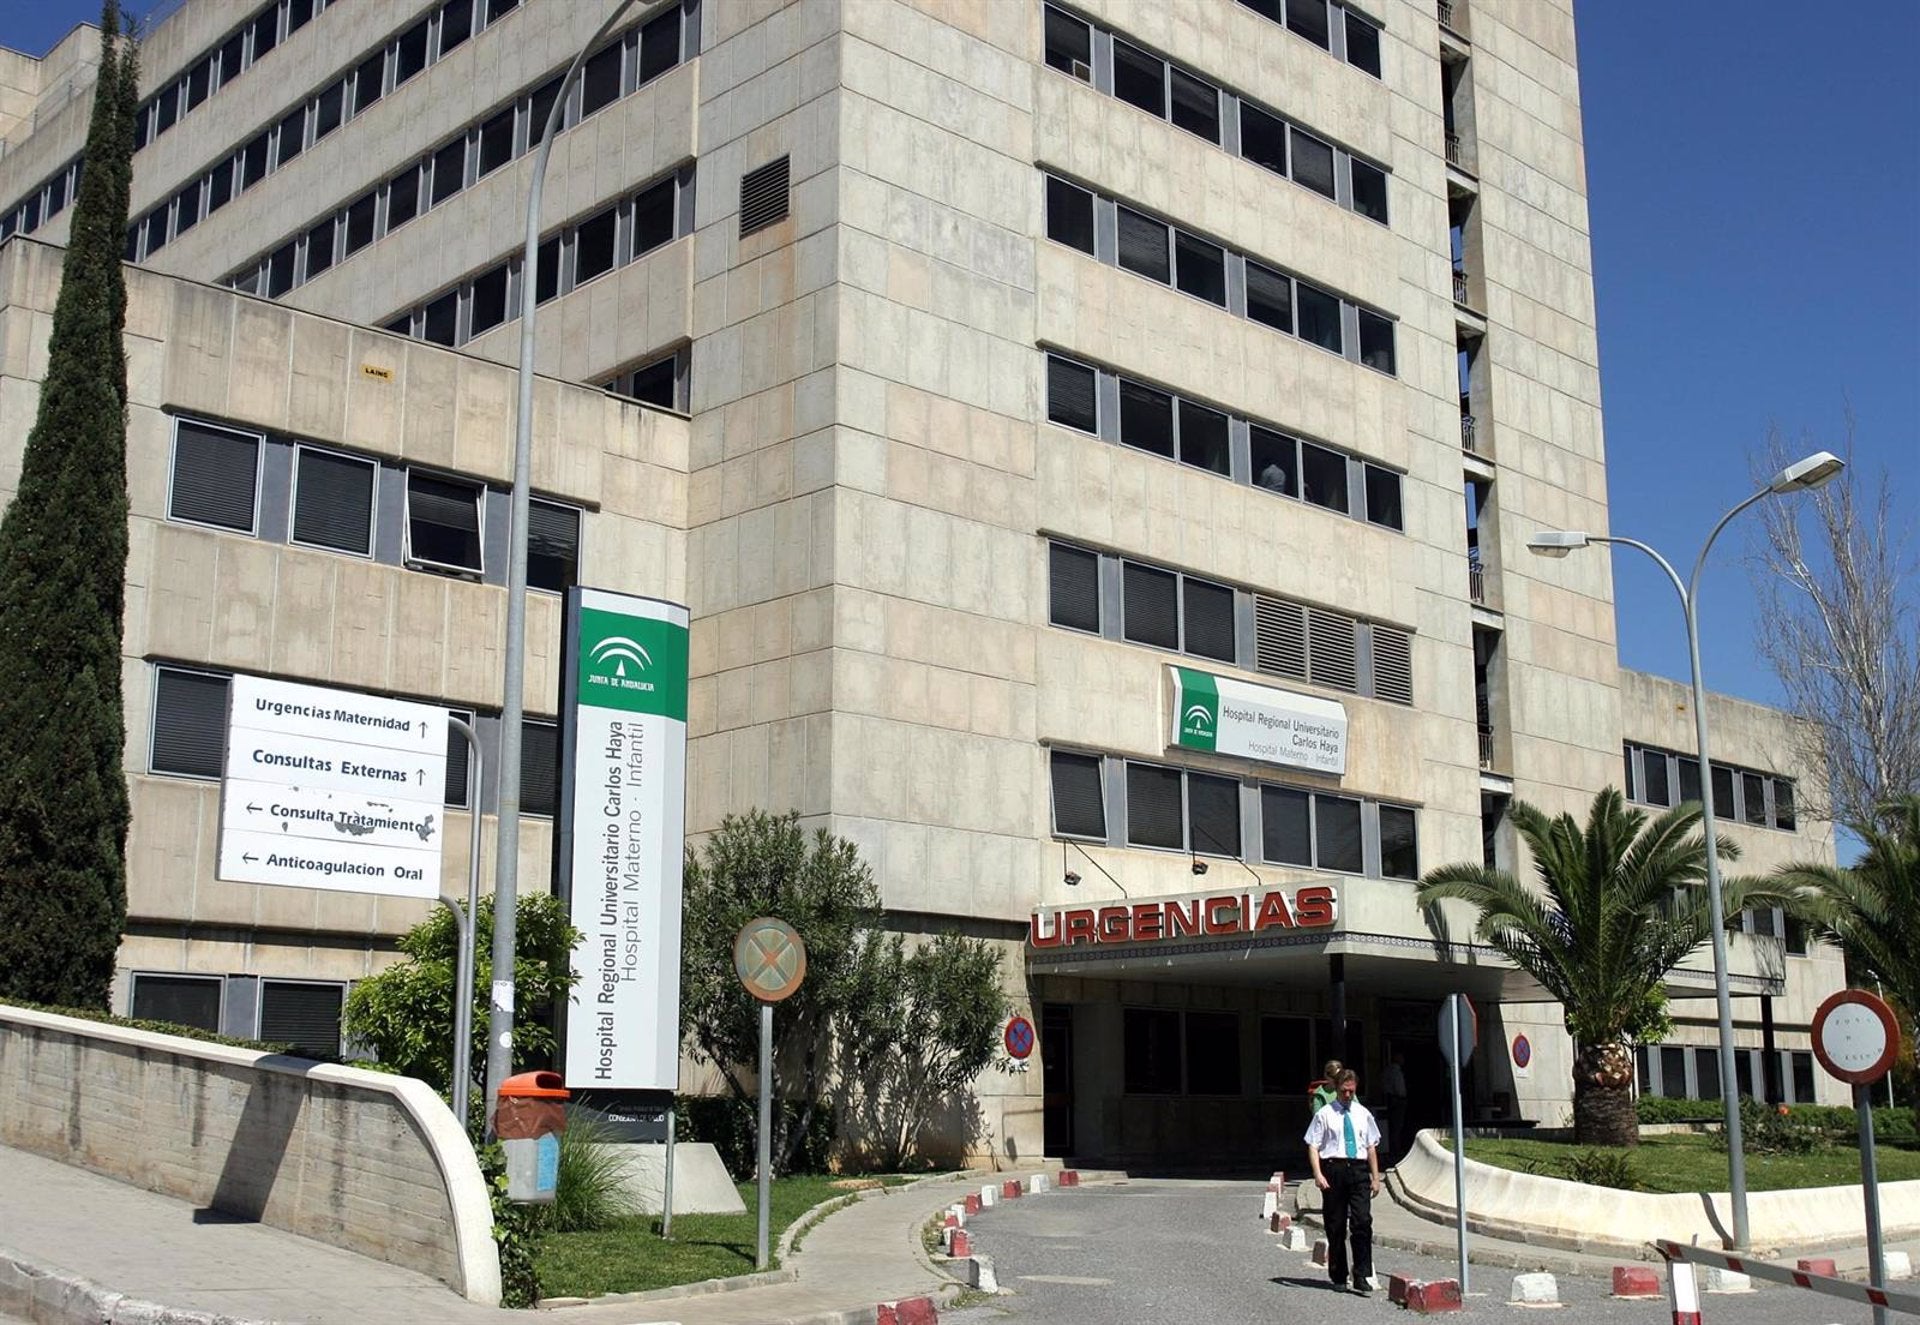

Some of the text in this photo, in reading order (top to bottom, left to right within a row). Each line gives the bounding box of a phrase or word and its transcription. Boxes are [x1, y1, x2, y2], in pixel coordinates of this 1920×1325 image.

[588, 674, 609, 685] JUNTA
[610, 677, 619, 687] DE
[256, 698, 410, 731] Urgencias Maternidad
[1222, 705, 1339, 739] Hospital Regional Universitario
[626, 722, 644, 787] Infantil
[1248, 740, 1278, 757] Hospital
[1280, 746, 1308, 761] Materno
[1292, 734, 1339, 755] Carlos Haya
[253, 749, 407, 782] Consultas Externas
[270, 804, 334, 823] Consulta
[266, 853, 423, 881] Anticoagulacion Oral
[623, 809, 642, 892] Materno
[595, 721, 626, 1080] Hospital Regional Universitario Carlos Haya
[1030, 886, 1338, 949] URGENCIAS
[620, 901, 642, 982] Hospital
